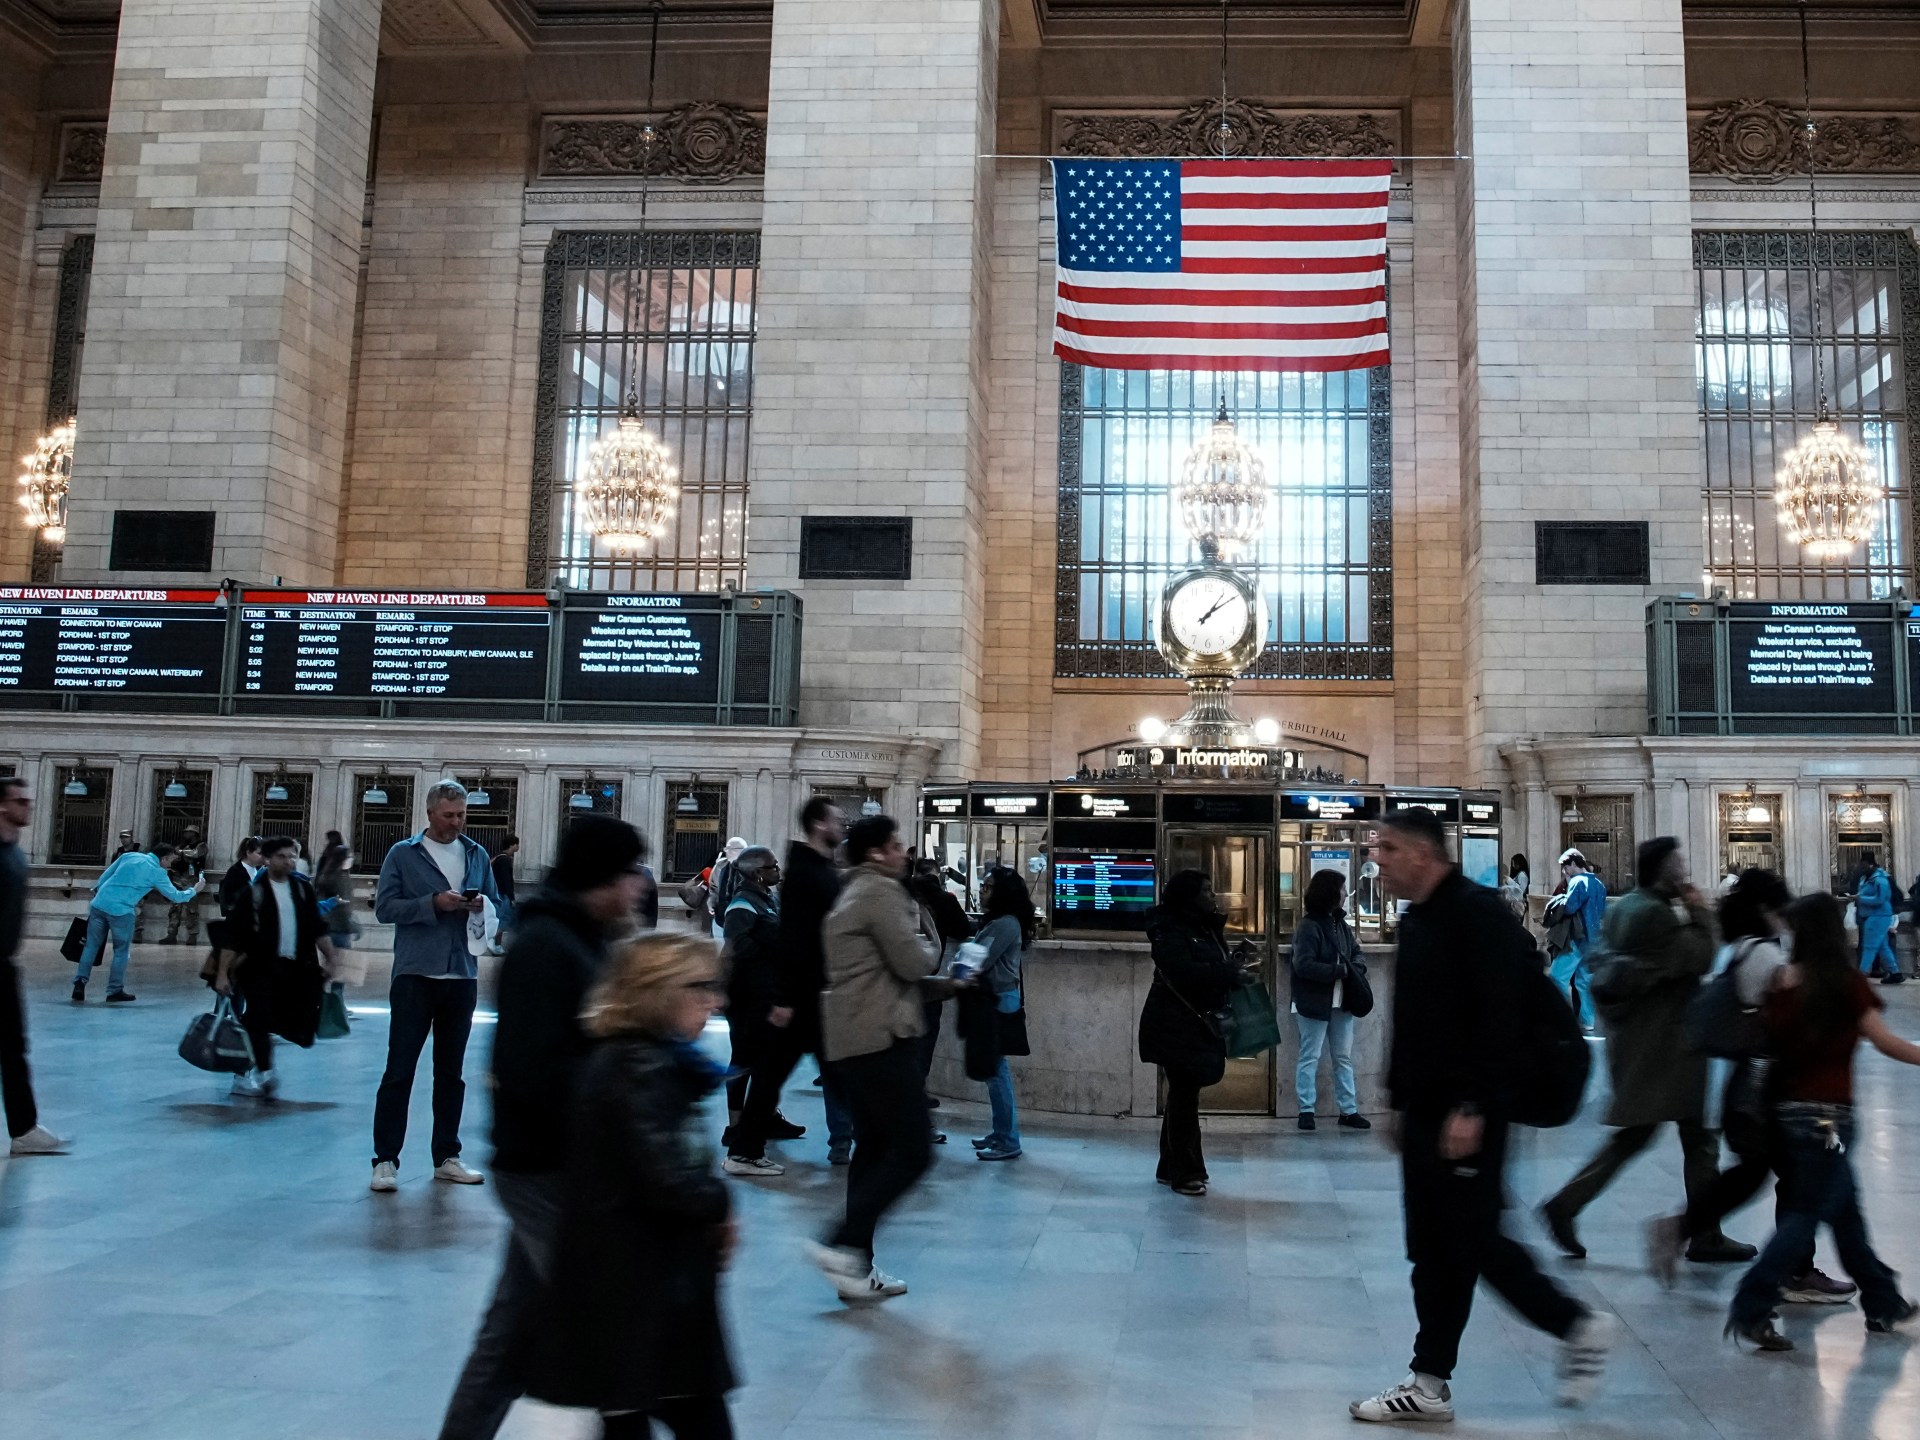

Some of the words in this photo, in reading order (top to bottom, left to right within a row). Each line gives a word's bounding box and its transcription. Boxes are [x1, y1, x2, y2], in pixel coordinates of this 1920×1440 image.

[0, 588, 22, 598] NEW
[24, 589, 64, 599] HAVEN
[66, 589, 92, 599] LINE
[94, 590, 167, 600] DEPARTURES
[307, 593, 335, 603] NEW
[336, 593, 378, 603] HAVEN
[380, 594, 408, 604] LINE
[410, 594, 486, 605] DEPARTURES
[607, 597, 681, 606] INFORMATION
[61, 608, 98, 616] REMARKS
[1772, 606, 1848, 615] INFORMATION
[300, 611, 356, 620] DESTINATION
[376, 612, 415, 621] REMARKS
[617, 615, 645, 623] Canaan
[647, 615, 686, 624] Customers
[627, 628, 654, 636] service,
[656, 628, 691, 637] excluding
[1765, 625, 1782, 633] New
[1784, 625, 1814, 633] Canaan
[1815, 625, 1856, 633] Customers
[583, 639, 616, 647] Memorial
[618, 639, 632, 649] Day
[634, 640, 670, 649] Weekend,
[680, 640, 700, 650] being
[1758, 637, 1794, 645] Weekend
[1795, 638, 1824, 646] service,
[1826, 638, 1862, 647] excluding
[433, 650, 467, 658] DANBURY,
[487, 651, 518, 659] CANAAN,
[580, 651, 610, 660] replaced
[612, 652, 621, 661] by
[646, 652, 674, 662] through
[1750, 650, 1785, 658] Memorial
[1787, 650, 1802, 660] Day
[1804, 650, 1841, 659] Weekend,
[1851, 650, 1872, 660] being
[581, 663, 606, 672] Details
[646, 664, 682, 673] TrainTime
[1748, 662, 1780, 672] replaced
[1782, 662, 1791, 672] by
[1817, 663, 1846, 672] through
[129, 668, 159, 676] CANAAN,
[1751, 675, 1776, 684] Details
[1818, 675, 1855, 684] TrainTime
[1250, 717, 1318, 734] VERBILT
[1320, 728, 1347, 742] HALL
[821, 750, 870, 760] CUSTOMER
[872, 753, 894, 761] SERVICE
[1177, 748, 1268, 766] Information
